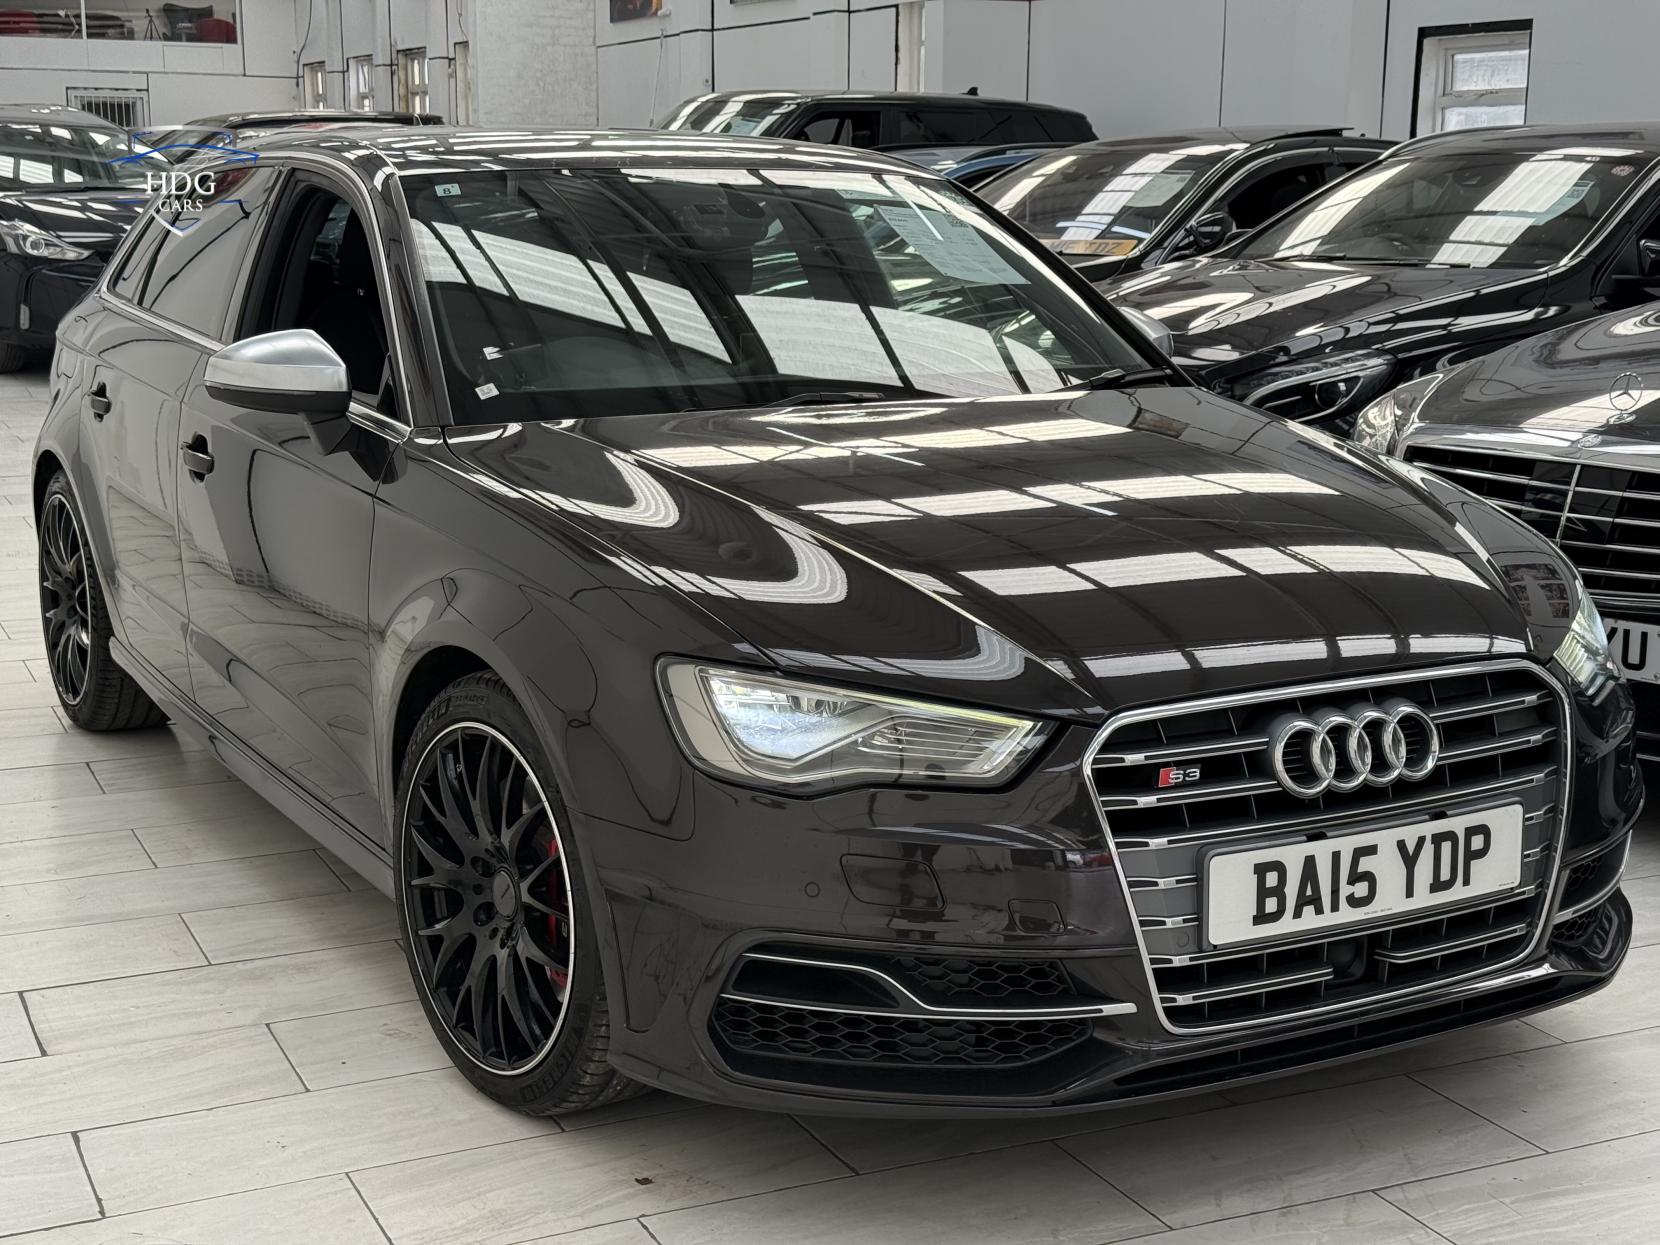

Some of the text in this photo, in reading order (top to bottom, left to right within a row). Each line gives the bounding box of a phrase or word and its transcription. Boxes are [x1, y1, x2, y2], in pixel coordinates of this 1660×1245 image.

[1168, 768, 1200, 783] S3
[1252, 824, 1492, 926] BA15 YDP
